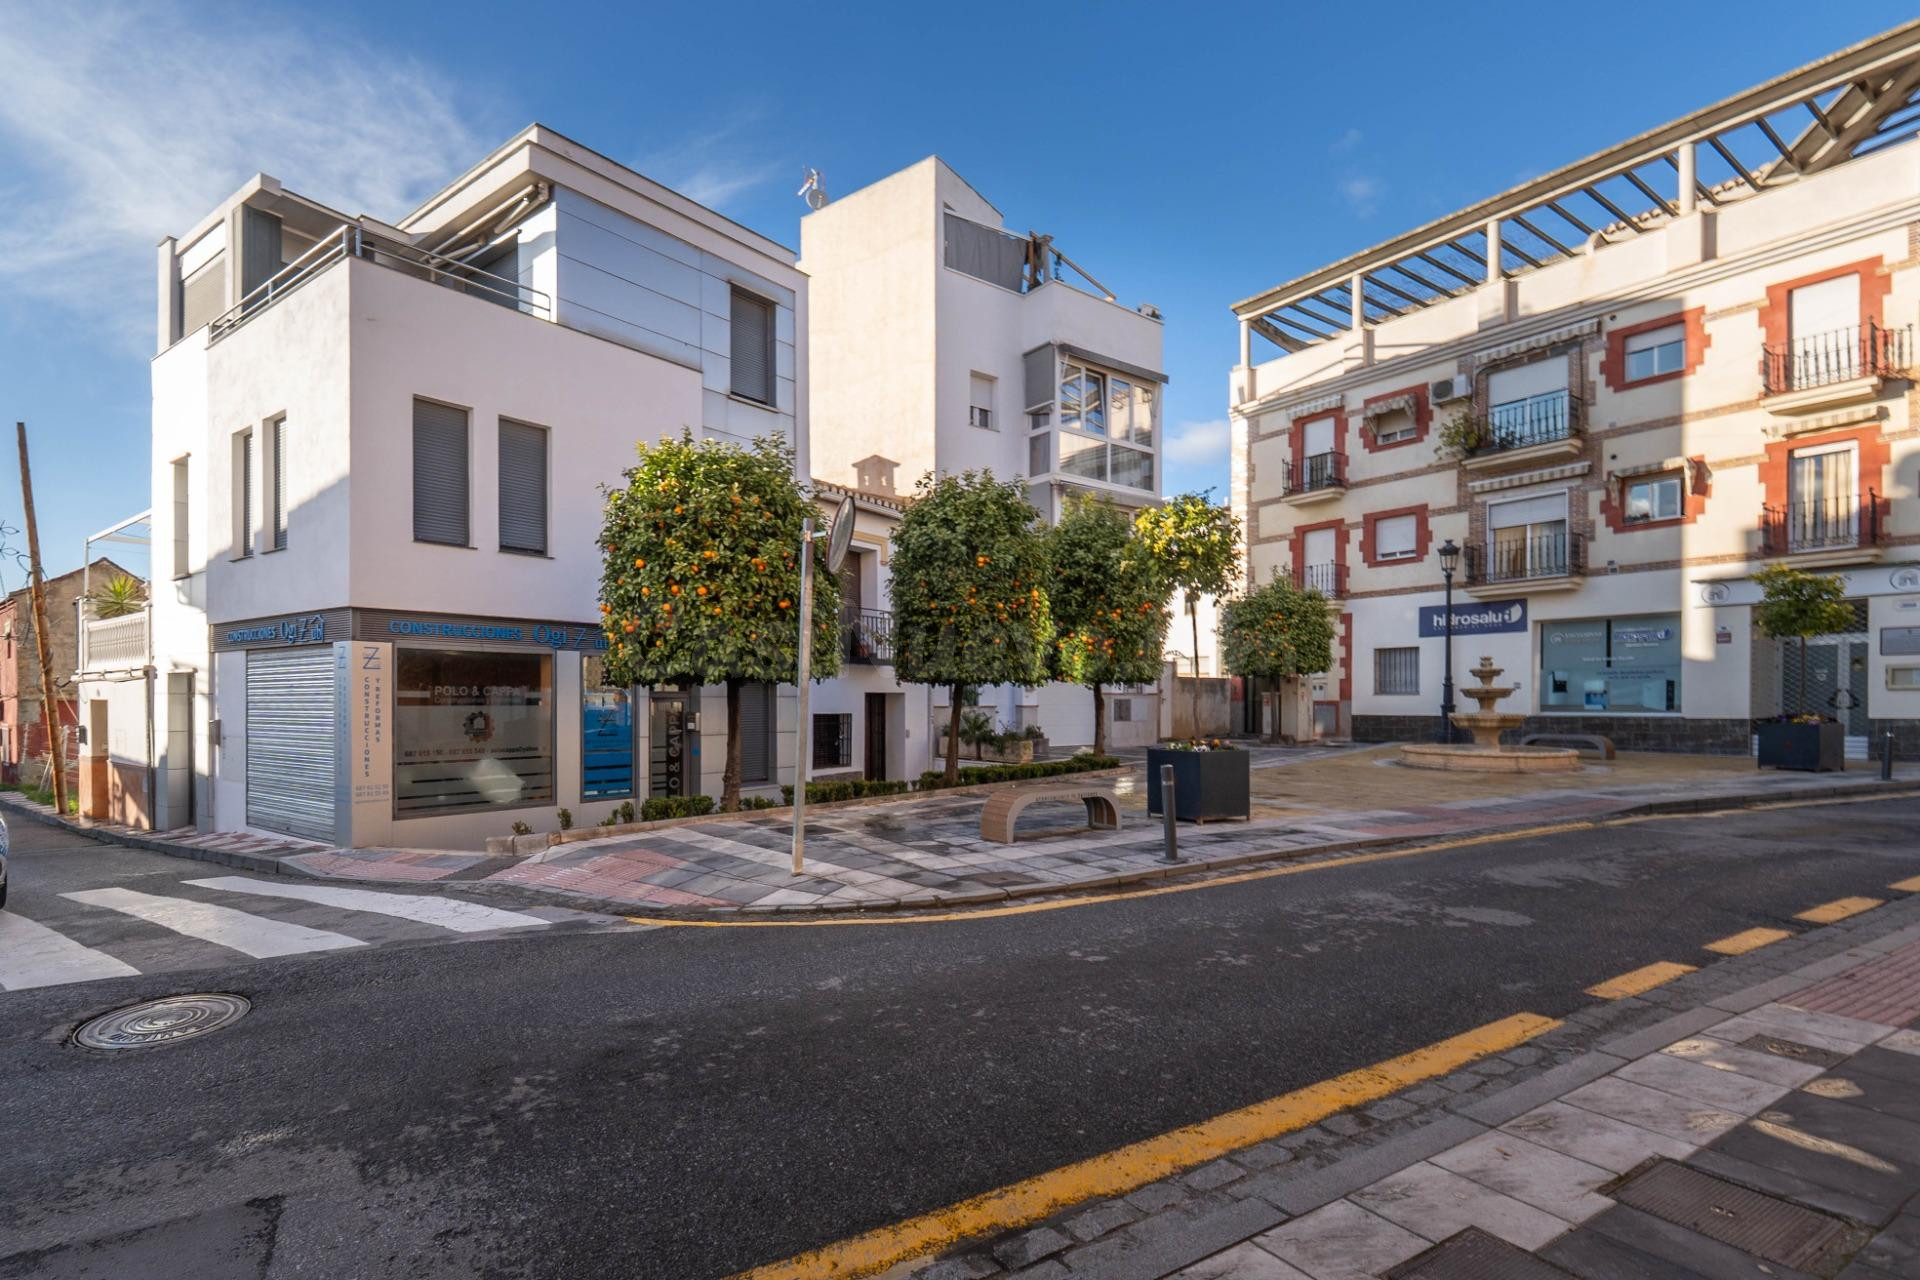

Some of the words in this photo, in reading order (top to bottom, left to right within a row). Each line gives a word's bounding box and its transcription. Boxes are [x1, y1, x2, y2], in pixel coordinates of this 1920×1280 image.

[227, 625, 276, 642] CONSTRUCCIONES
[388, 619, 522, 641] CONSTRUCCIONES
[532, 623, 567, 648] Ogi
[434, 686, 469, 696] POLO
[471, 686, 480, 696] &
[669, 762, 680, 773] &
